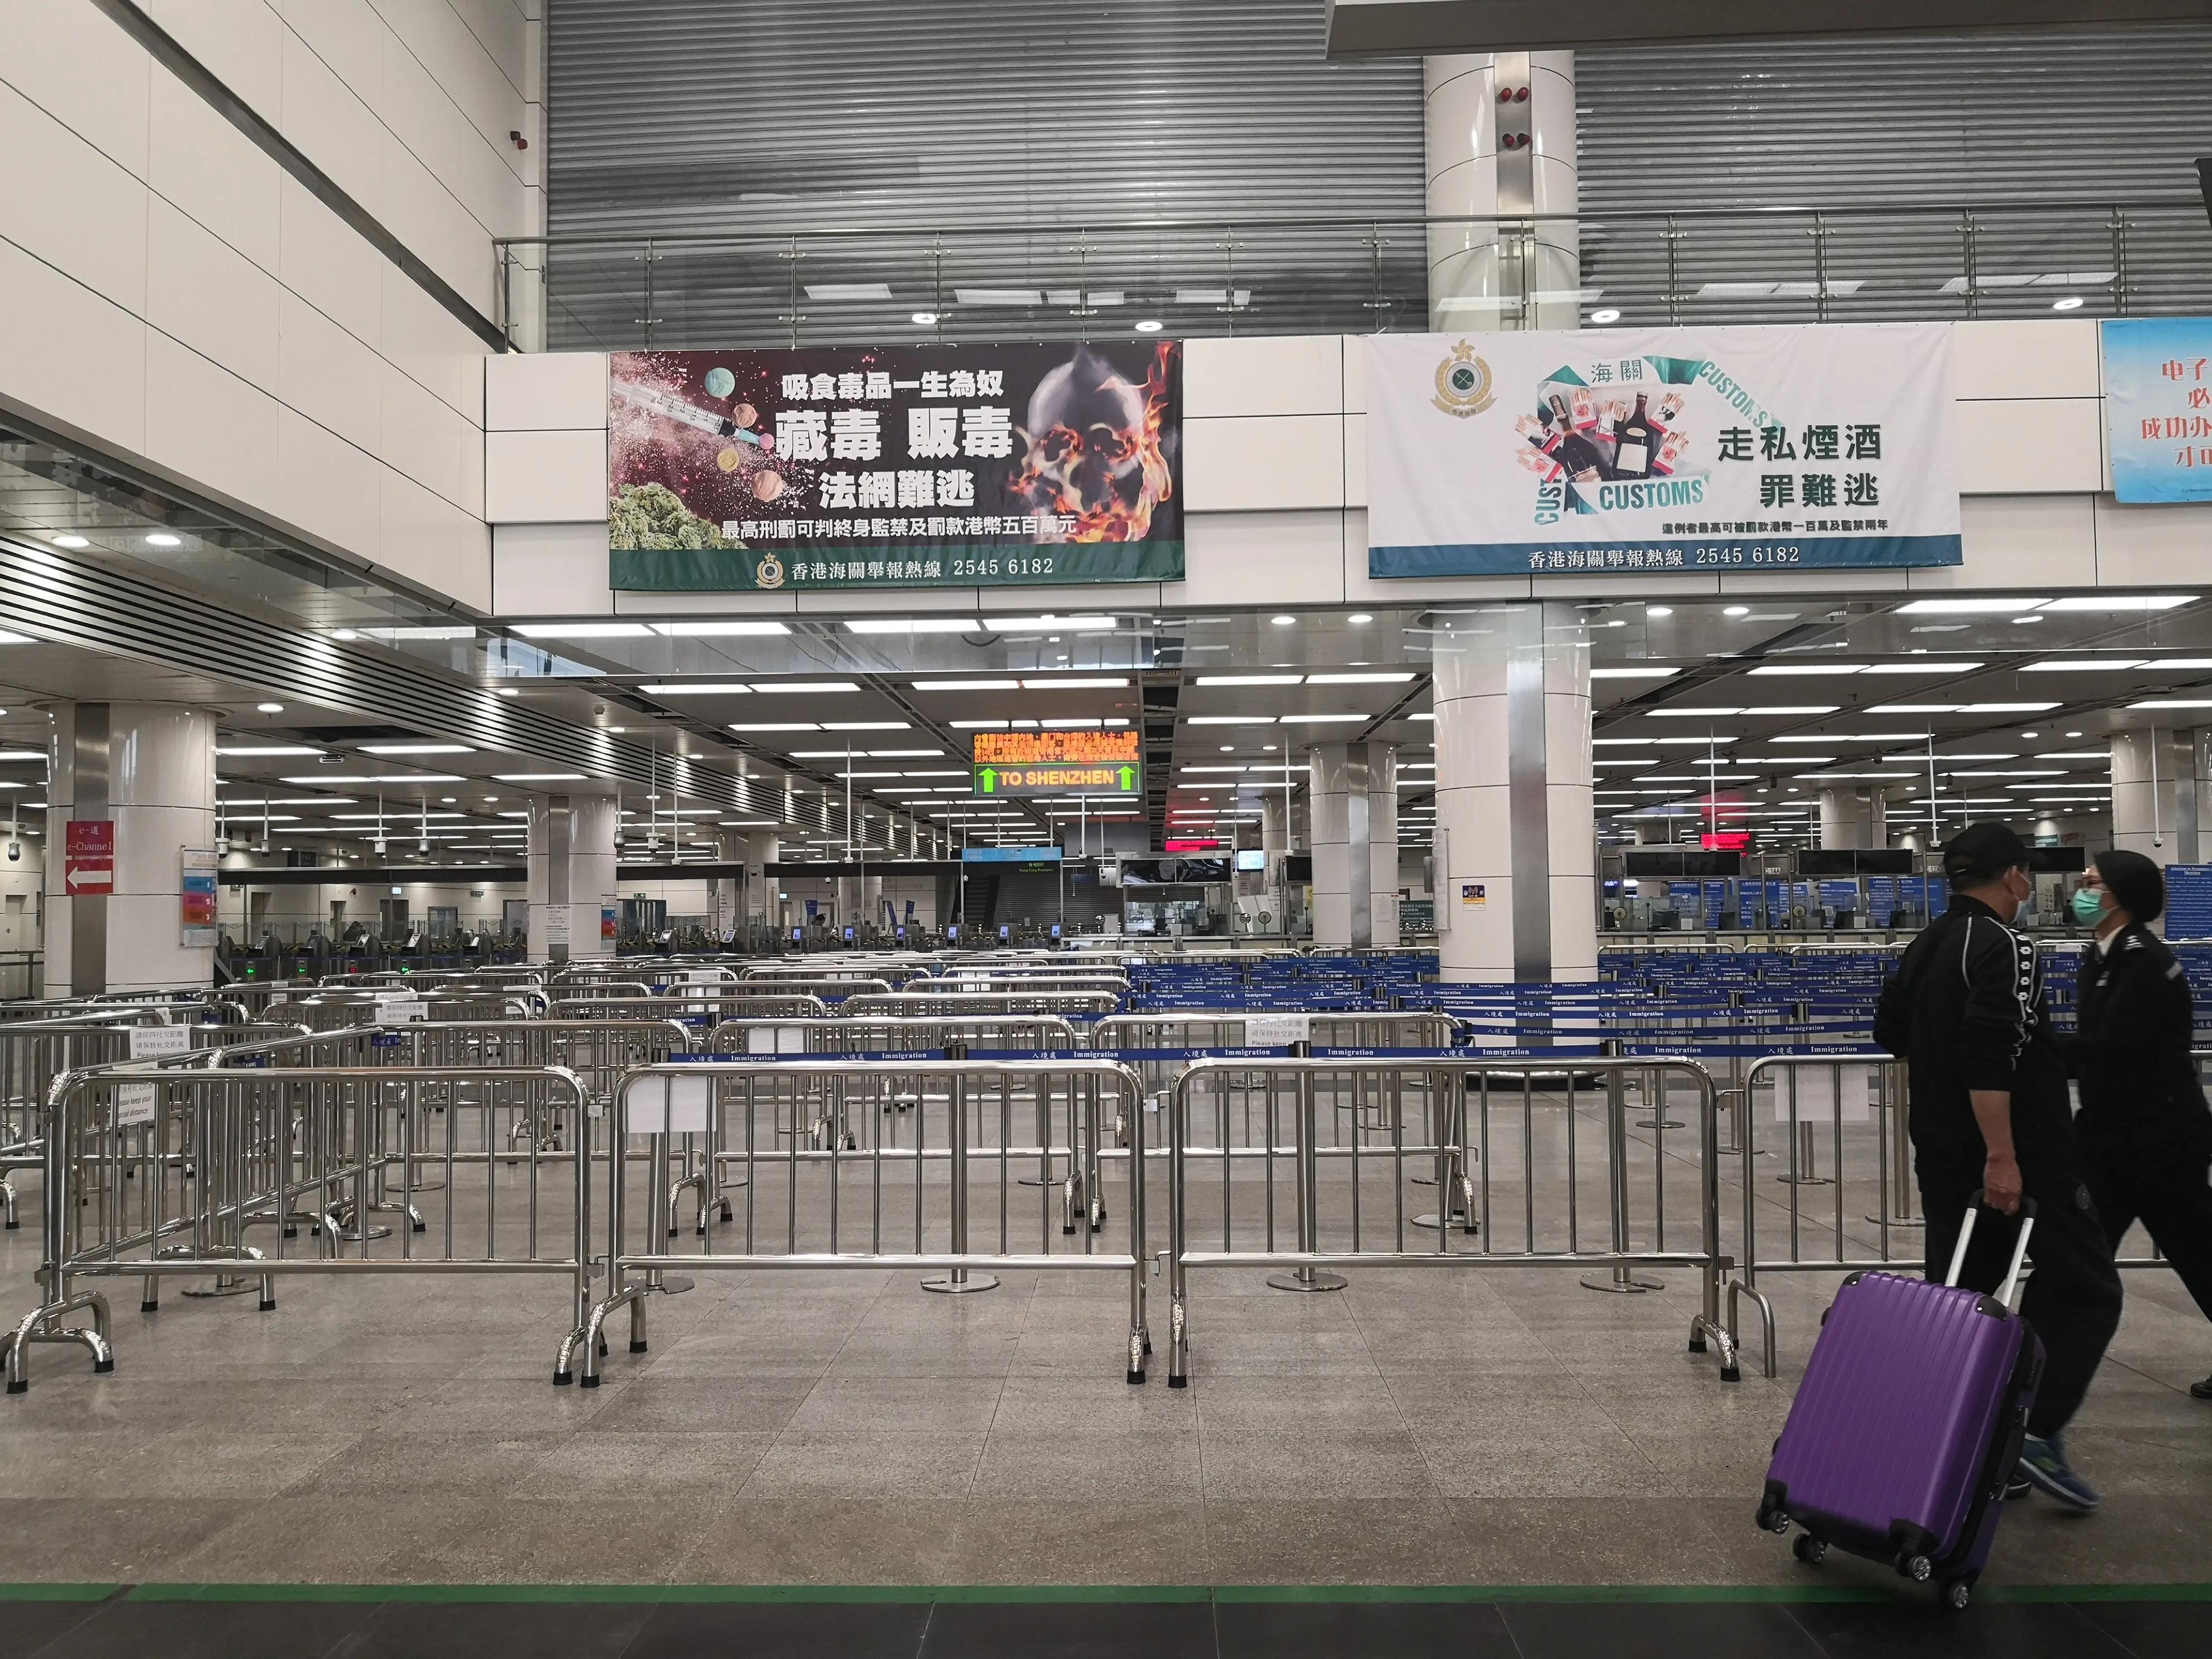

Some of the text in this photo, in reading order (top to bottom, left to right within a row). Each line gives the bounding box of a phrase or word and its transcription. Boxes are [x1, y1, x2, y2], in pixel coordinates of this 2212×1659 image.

[1591, 360, 1643, 383] 海關
[2162, 358, 2211, 381] 电子
[782, 370, 1003, 400] 吸食毒品一生為奴
[1698, 361, 1769, 429] CUSTOMS
[2189, 387, 2211, 409] 必
[775, 406, 1012, 462] 藏毒 販毒
[2141, 416, 2211, 439] 成功办
[1718, 424, 1880, 462] 走私煙酒
[818, 469, 974, 509] 法網難逃
[1599, 478, 1704, 511] CUSTOMS
[1760, 473, 1879, 508] 罪難逃
[722, 518, 1076, 540] 最高刑罰可判終身監禁及罰款港幣五百萬元
[1528, 547, 1799, 569] 香港海關舉報熱線 2545 6182
[791, 559, 1054, 580] 香港海關舉報熱線 2545 6182
[999, 770, 1114, 785] TO SHENZHEN
[79, 826, 99, 835] e-道
[67, 842, 111, 851] e-Channel
[1032, 1051, 1057, 1060] 入境處
[1623, 1046, 1638, 1055] 境處
[1768, 1047, 1794, 1055] 入境處
[1811, 1045, 1857, 1054] Immigration
[118, 1109, 129, 1118] ocial
